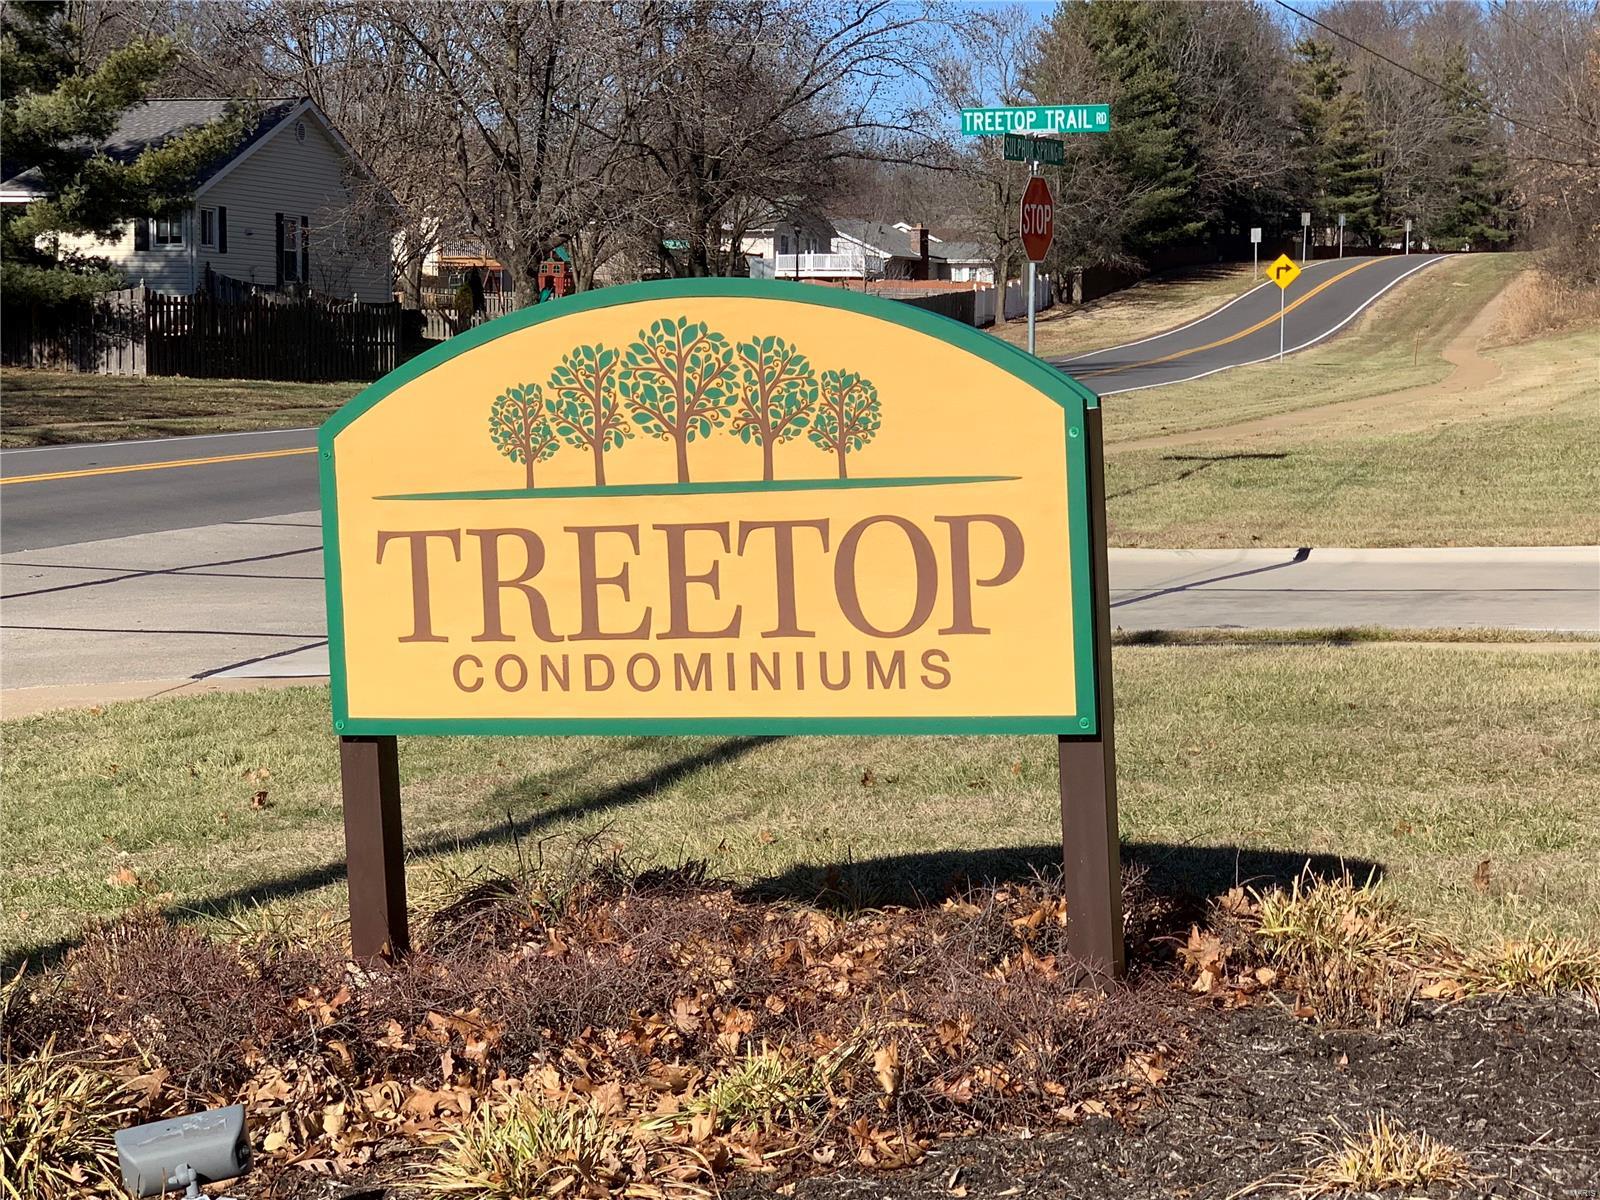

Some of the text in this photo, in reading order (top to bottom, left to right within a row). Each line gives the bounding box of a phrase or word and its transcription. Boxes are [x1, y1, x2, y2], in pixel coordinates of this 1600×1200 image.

[964, 109, 1107, 132] TREETOP TRAIL RD
[1005, 137, 1034, 159] SULPHUR
[1023, 203, 1051, 234] STOP
[376, 514, 1025, 643] TREETOP
[453, 649, 952, 692] CONDOMINIUMS
